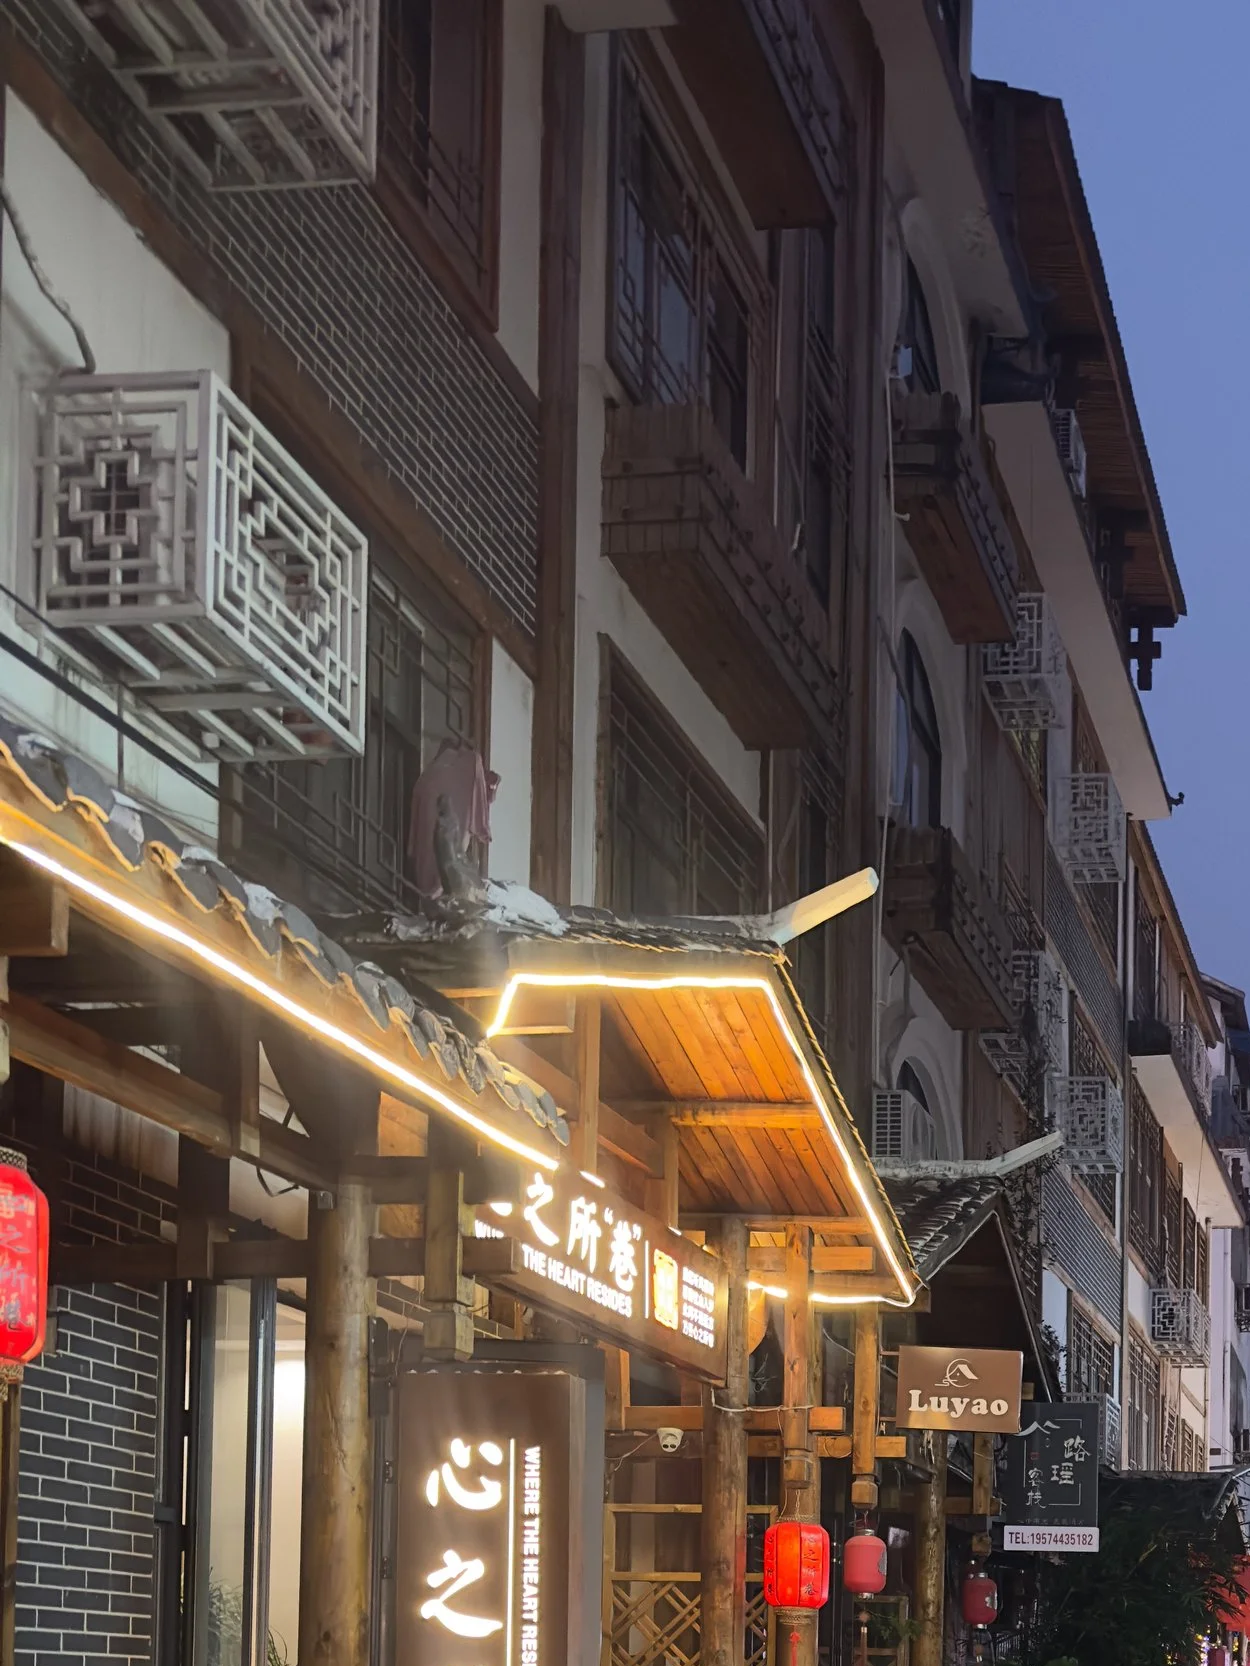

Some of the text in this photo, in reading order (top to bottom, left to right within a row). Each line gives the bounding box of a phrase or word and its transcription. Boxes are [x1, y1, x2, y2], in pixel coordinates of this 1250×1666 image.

[521, 1244, 546, 1277] THE
[547, 1256, 586, 1296] HEART
[586, 1277, 633, 1318] RESIDES
[908, 1389, 1009, 1418] Luyao
[524, 1446, 541, 1516] WHERE
[523, 1518, 540, 1556] THE
[1008, 1532, 1094, 1546] TEL:19574435182
[522, 1558, 539, 1623] HEART
